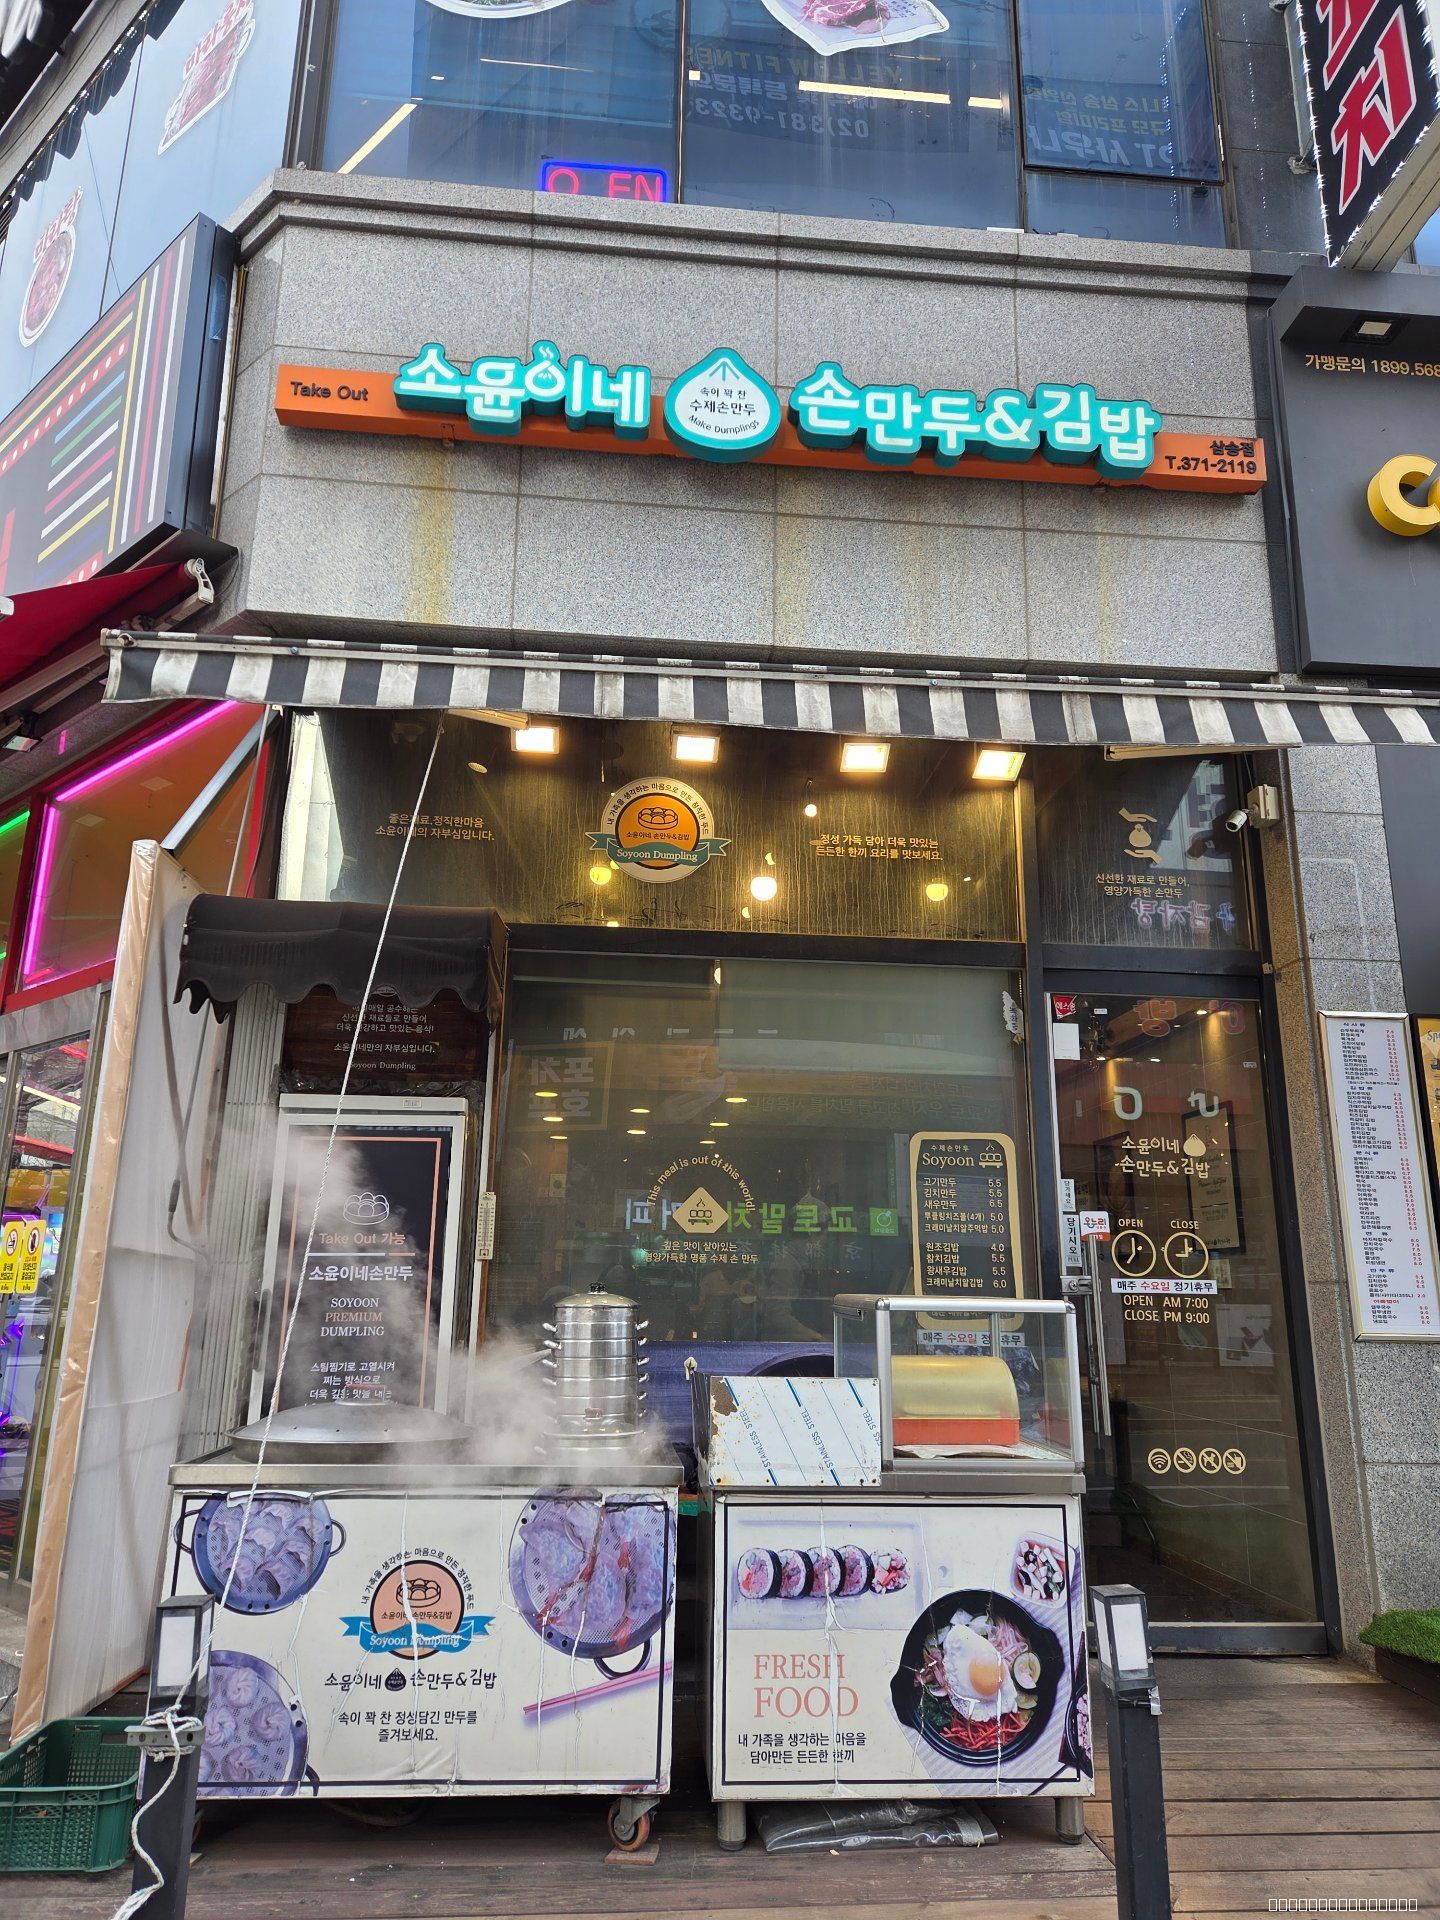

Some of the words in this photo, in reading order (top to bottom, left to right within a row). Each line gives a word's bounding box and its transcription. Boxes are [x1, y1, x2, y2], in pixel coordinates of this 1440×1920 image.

[1305, 354, 1366, 373] 가맹문의
[399, 343, 645, 425] 소윤이네
[290, 381, 331, 399] Take
[337, 385, 369, 402] Out
[700, 387, 719, 398] 속이
[737, 390, 746, 399] 찬
[689, 399, 756, 416] 수제손만두
[803, 367, 1156, 461] 손만두&김밥
[688, 414, 712, 431] Make
[714, 419, 760, 435] Dumplings
[1209, 439, 1256, 458] 삼송점
[1165, 456, 1258, 476] T.371-2119
[624, 785, 650, 800] 생각하는
[651, 783, 679, 794] 마음으로
[430, 828, 495, 841] 자부심입니다.
[626, 831, 652, 839] 소윤이네
[820, 834, 840, 845] 정성
[842, 835, 862, 846] 가득
[865, 836, 884, 847] 담아
[887, 836, 907, 848] 더욱
[909, 837, 939, 849] 맛있는
[617, 848, 651, 860] Soyoon
[653, 851, 698, 862] Dumpling
[816, 845, 845, 857] 든든한
[848, 847, 867, 858] 한끼
[869, 847, 899, 859] 요리를
[902, 849, 944, 861] 맛보세요.
[1095, 873, 1124, 884] 신선한
[1126, 874, 1156, 885] 재료로
[1158, 876, 1190, 887] 만들어,
[1104, 885, 1152, 897] 영양가득한
[1154, 887, 1183, 899] 손만두
[389, 1024, 413, 1033] 맛있는
[385, 1044, 436, 1054] 자부심입니다.
[380, 1061, 416, 1071] Dumpling
[1122, 1136, 1181, 1154] 소윤이네
[922, 1152, 975, 1169] Soyoon
[1120, 1155, 1210, 1178] 손만두&김밥
[647, 1185, 661, 1206] This
[657, 1162, 678, 1185] meal
[678, 1158, 689, 1168] is
[691, 1155, 709, 1165] out
[711, 1158, 723, 1168] of
[722, 1162, 740, 1180] this
[738, 1179, 756, 1211] world!
[923, 1177, 957, 1187] 고기만두
[988, 1178, 1002, 1188] 5.5
[923, 1188, 958, 1199] 김치만두
[988, 1189, 1003, 1198] 5.5
[924, 1200, 958, 1210] 새우만두
[989, 1199, 1003, 1208] 6.5
[990, 1212, 1004, 1222] 5.0
[1118, 1218, 1144, 1228] OPEN
[1170, 1219, 1200, 1230] CLOSE
[991, 1224, 1005, 1234] 5.0
[1067, 1218, 1077, 1254] 당기시오
[319, 1233, 349, 1245] Take
[353, 1233, 377, 1245] Out
[382, 1232, 406, 1245] 가능
[683, 1241, 700, 1251] 맛이
[703, 1241, 738, 1252] 살아있는
[925, 1242, 960, 1253] 원조김밥
[991, 1243, 1005, 1252] 4.0
[690, 1253, 708, 1264] 명품
[710, 1253, 728, 1264] 수제
[730, 1254, 739, 1264] 손
[741, 1254, 760, 1265] 만두
[926, 1253, 960, 1264] 참치김밥
[991, 1253, 1005, 1263] 5.5
[308, 1265, 414, 1282] 소윤이네손만두
[926, 1265, 967, 1276] 왕새우김밥
[992, 1266, 1006, 1276] 5.5
[993, 1279, 1007, 1289] 6.0
[1117, 1280, 1137, 1291] 매주
[1140, 1281, 1171, 1292] 수요일
[1173, 1282, 1214, 1293] 정기휴무
[330, 1298, 380, 1308] SOYOON
[1123, 1295, 1154, 1307] OPEN
[1163, 1296, 1182, 1308] AM
[1184, 1297, 1209, 1309] 7:00
[325, 1312, 383, 1323] PREMIUM
[1124, 1310, 1159, 1322] CLOSE
[1163, 1311, 1182, 1323] PM
[1185, 1312, 1210, 1324] 9:00
[320, 1327, 385, 1337] DUMPLING
[923, 1332, 943, 1343] 매주
[947, 1332, 977, 1344] 수요일
[358, 1361, 396, 1372] 고열시켜
[309, 1389, 328, 1399] 더욱
[739, 1409, 753, 1430] STEEL
[801, 1408, 815, 1430] STEEL
[862, 1409, 877, 1431] STEEL
[749, 1430, 771, 1468] STAINLESS
[811, 1431, 834, 1469] STAINLESS
[414, 1547, 445, 1560] 마음으로
[445, 1555, 459, 1571] 만든
[364, 1570, 383, 1594] 가족을
[457, 1568, 473, 1593] 정직한
[361, 1595, 370, 1605] 내
[465, 1594, 475, 1611] 푸드
[369, 1635, 408, 1648] Soyoon
[753, 1653, 846, 1680] FRESH
[324, 1672, 382, 1692] 소윤이네
[410, 1668, 497, 1690] 손만두&김밥
[753, 1686, 859, 1719] FOOD
[338, 1711, 361, 1725] 속이
[364, 1712, 376, 1725] 꽉
[380, 1712, 391, 1725] 찬
[444, 1711, 478, 1725] 만두를
[378, 1728, 438, 1743] 즐겨보세요.
[738, 1733, 748, 1746] 내
[752, 1733, 785, 1746] 가족을
[788, 1732, 830, 1746] 생각하는
[834, 1732, 867, 1746] 마음을
[750, 1751, 794, 1765] 담아만든
[797, 1750, 829, 1764] 든든한
